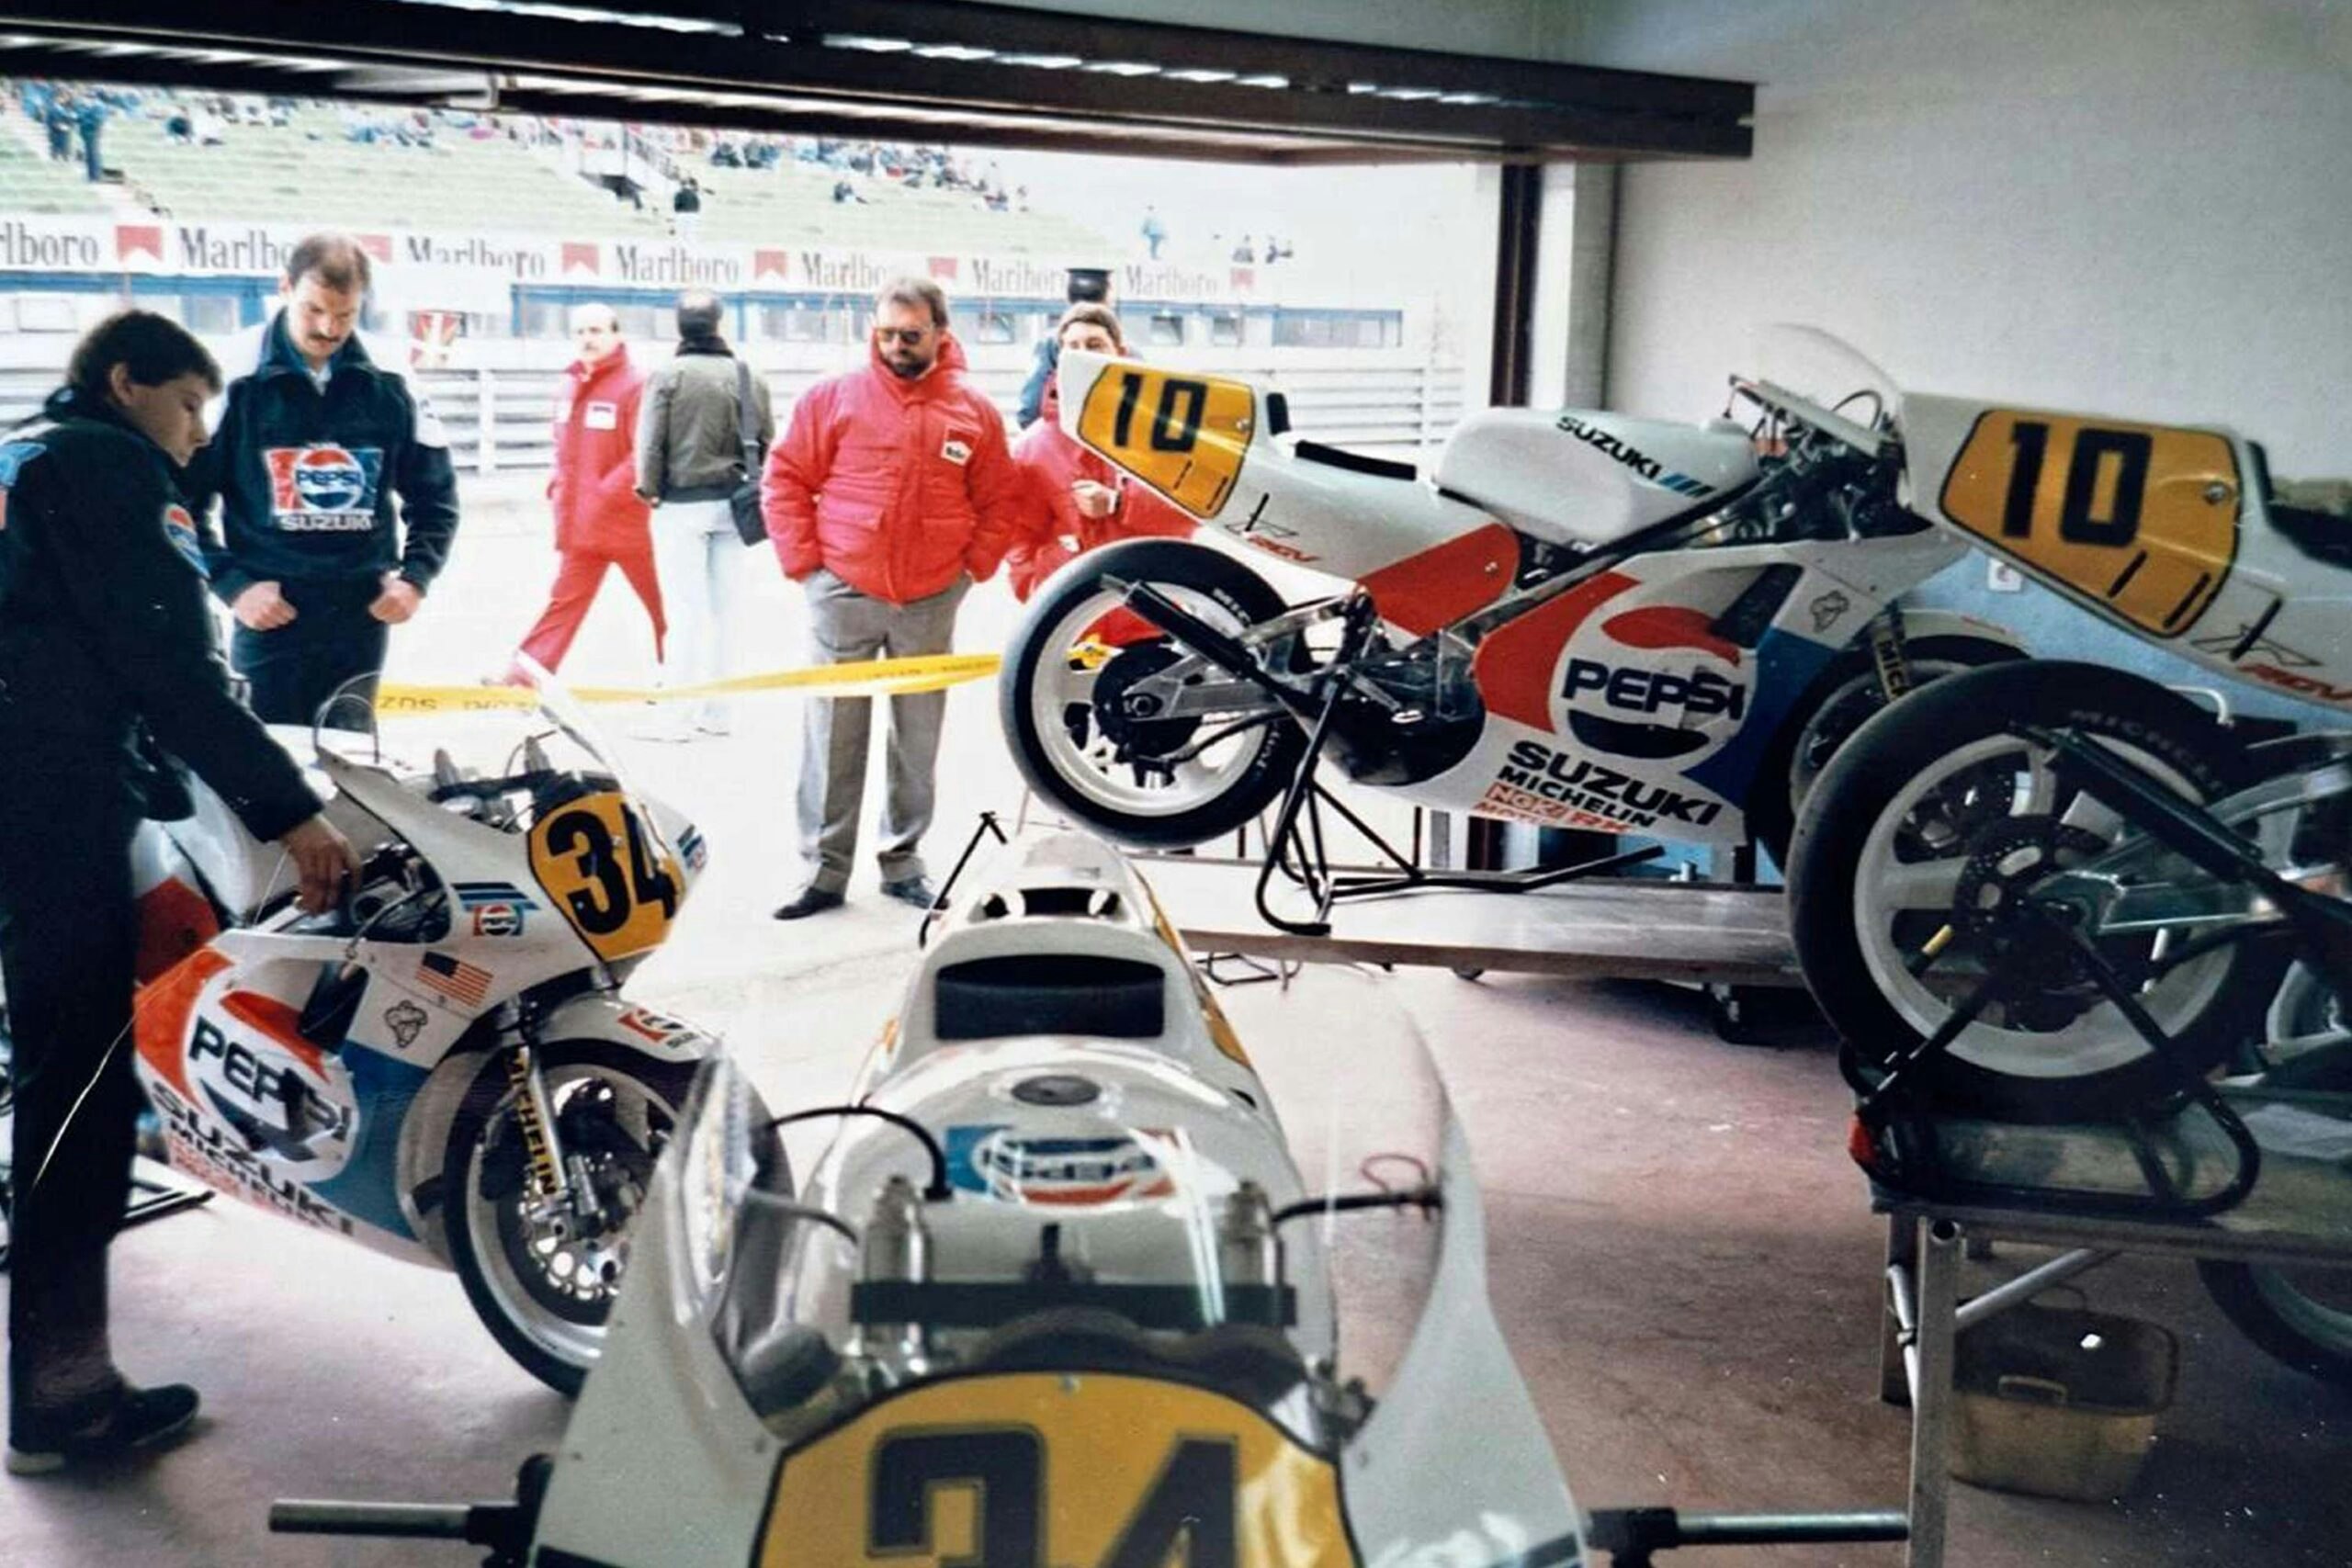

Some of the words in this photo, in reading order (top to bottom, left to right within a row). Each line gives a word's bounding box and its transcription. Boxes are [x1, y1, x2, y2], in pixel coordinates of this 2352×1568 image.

[616, 244, 739, 283] Marlboro
[1114, 372, 1206, 455] 10
[1556, 416, 1662, 479] SUZUKI
[2001, 421, 2154, 548] 10
[1561, 658, 1746, 721] PEPSI
[1497, 765, 1657, 827] MICHELIN
[1508, 739, 1723, 825] SUZUKI
[547, 802, 677, 935] 34
[153, 1081, 354, 1236] SUZUKI
